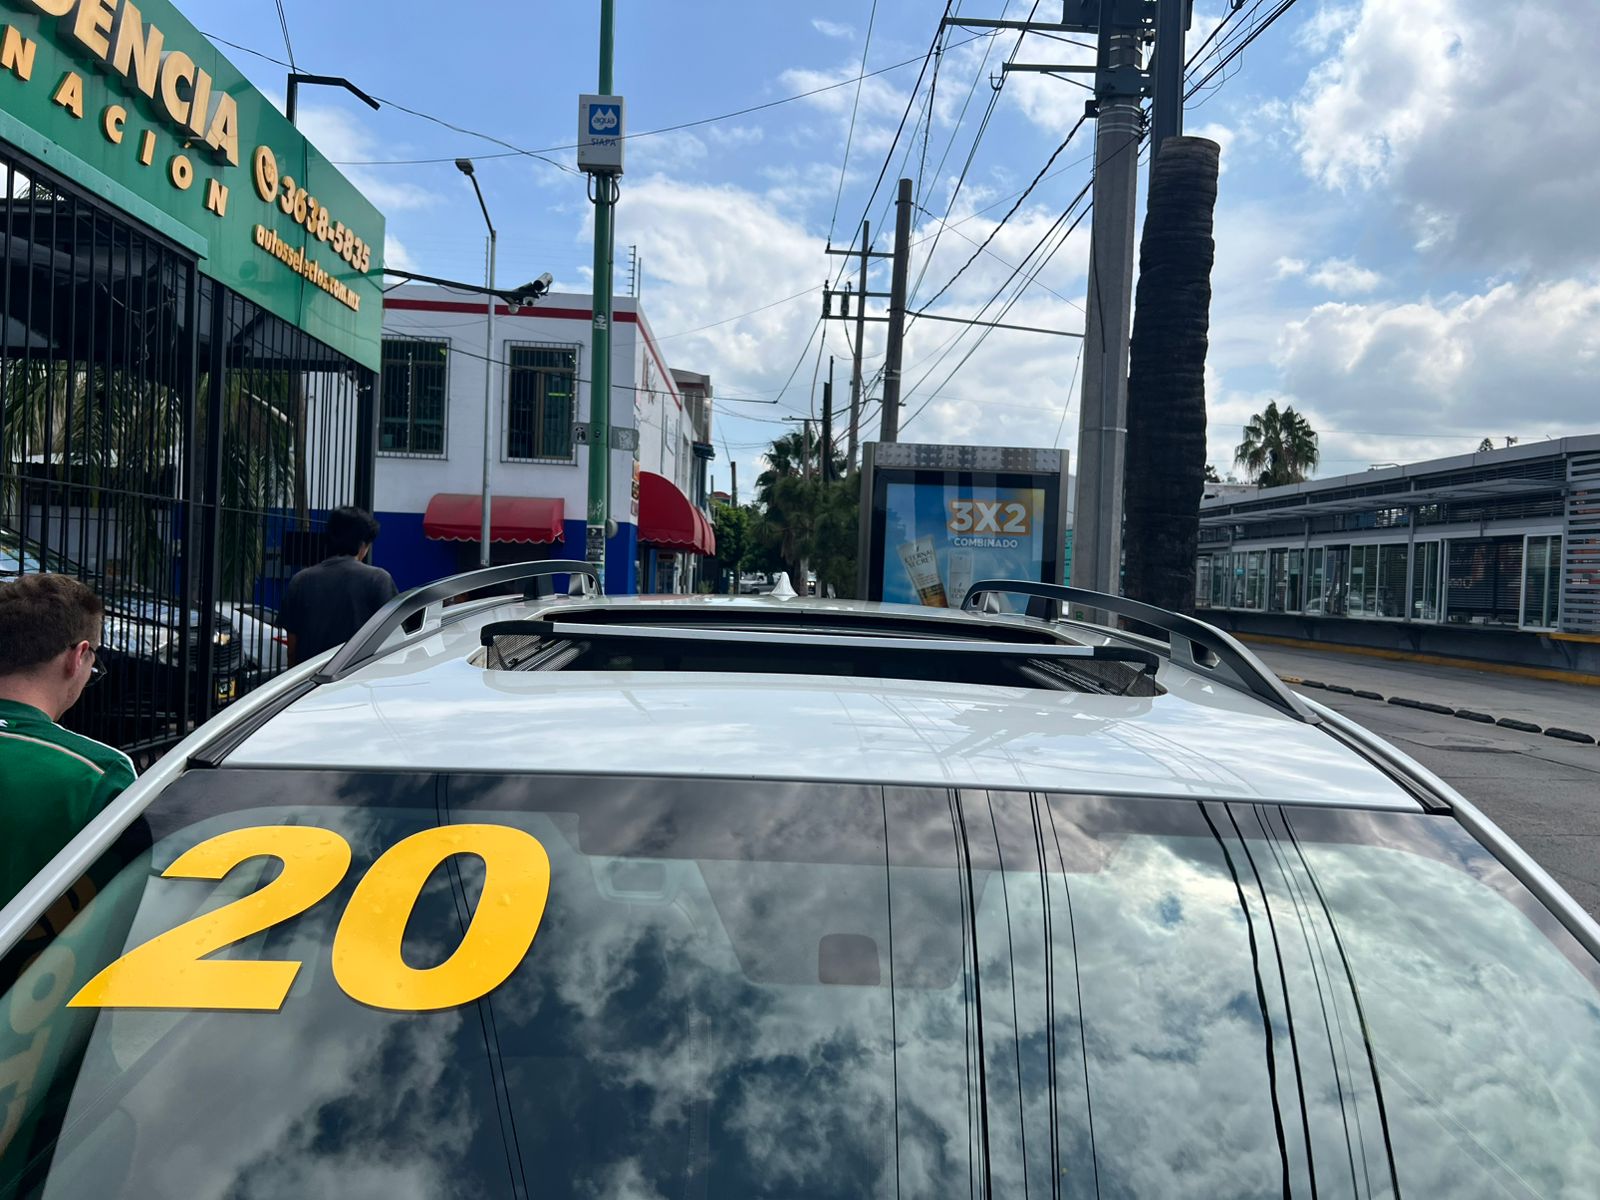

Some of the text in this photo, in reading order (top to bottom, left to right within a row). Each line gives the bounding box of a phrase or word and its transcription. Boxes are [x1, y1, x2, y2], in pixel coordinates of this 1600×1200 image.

[30, 0, 239, 168] ENCIA
[591, 138, 617, 147] SIAPA
[280, 175, 371, 273] 3638-5835
[950, 501, 1027, 533] 3X2
[953, 537, 1018, 548] COMBINADO
[66, 823, 551, 1011] 20
